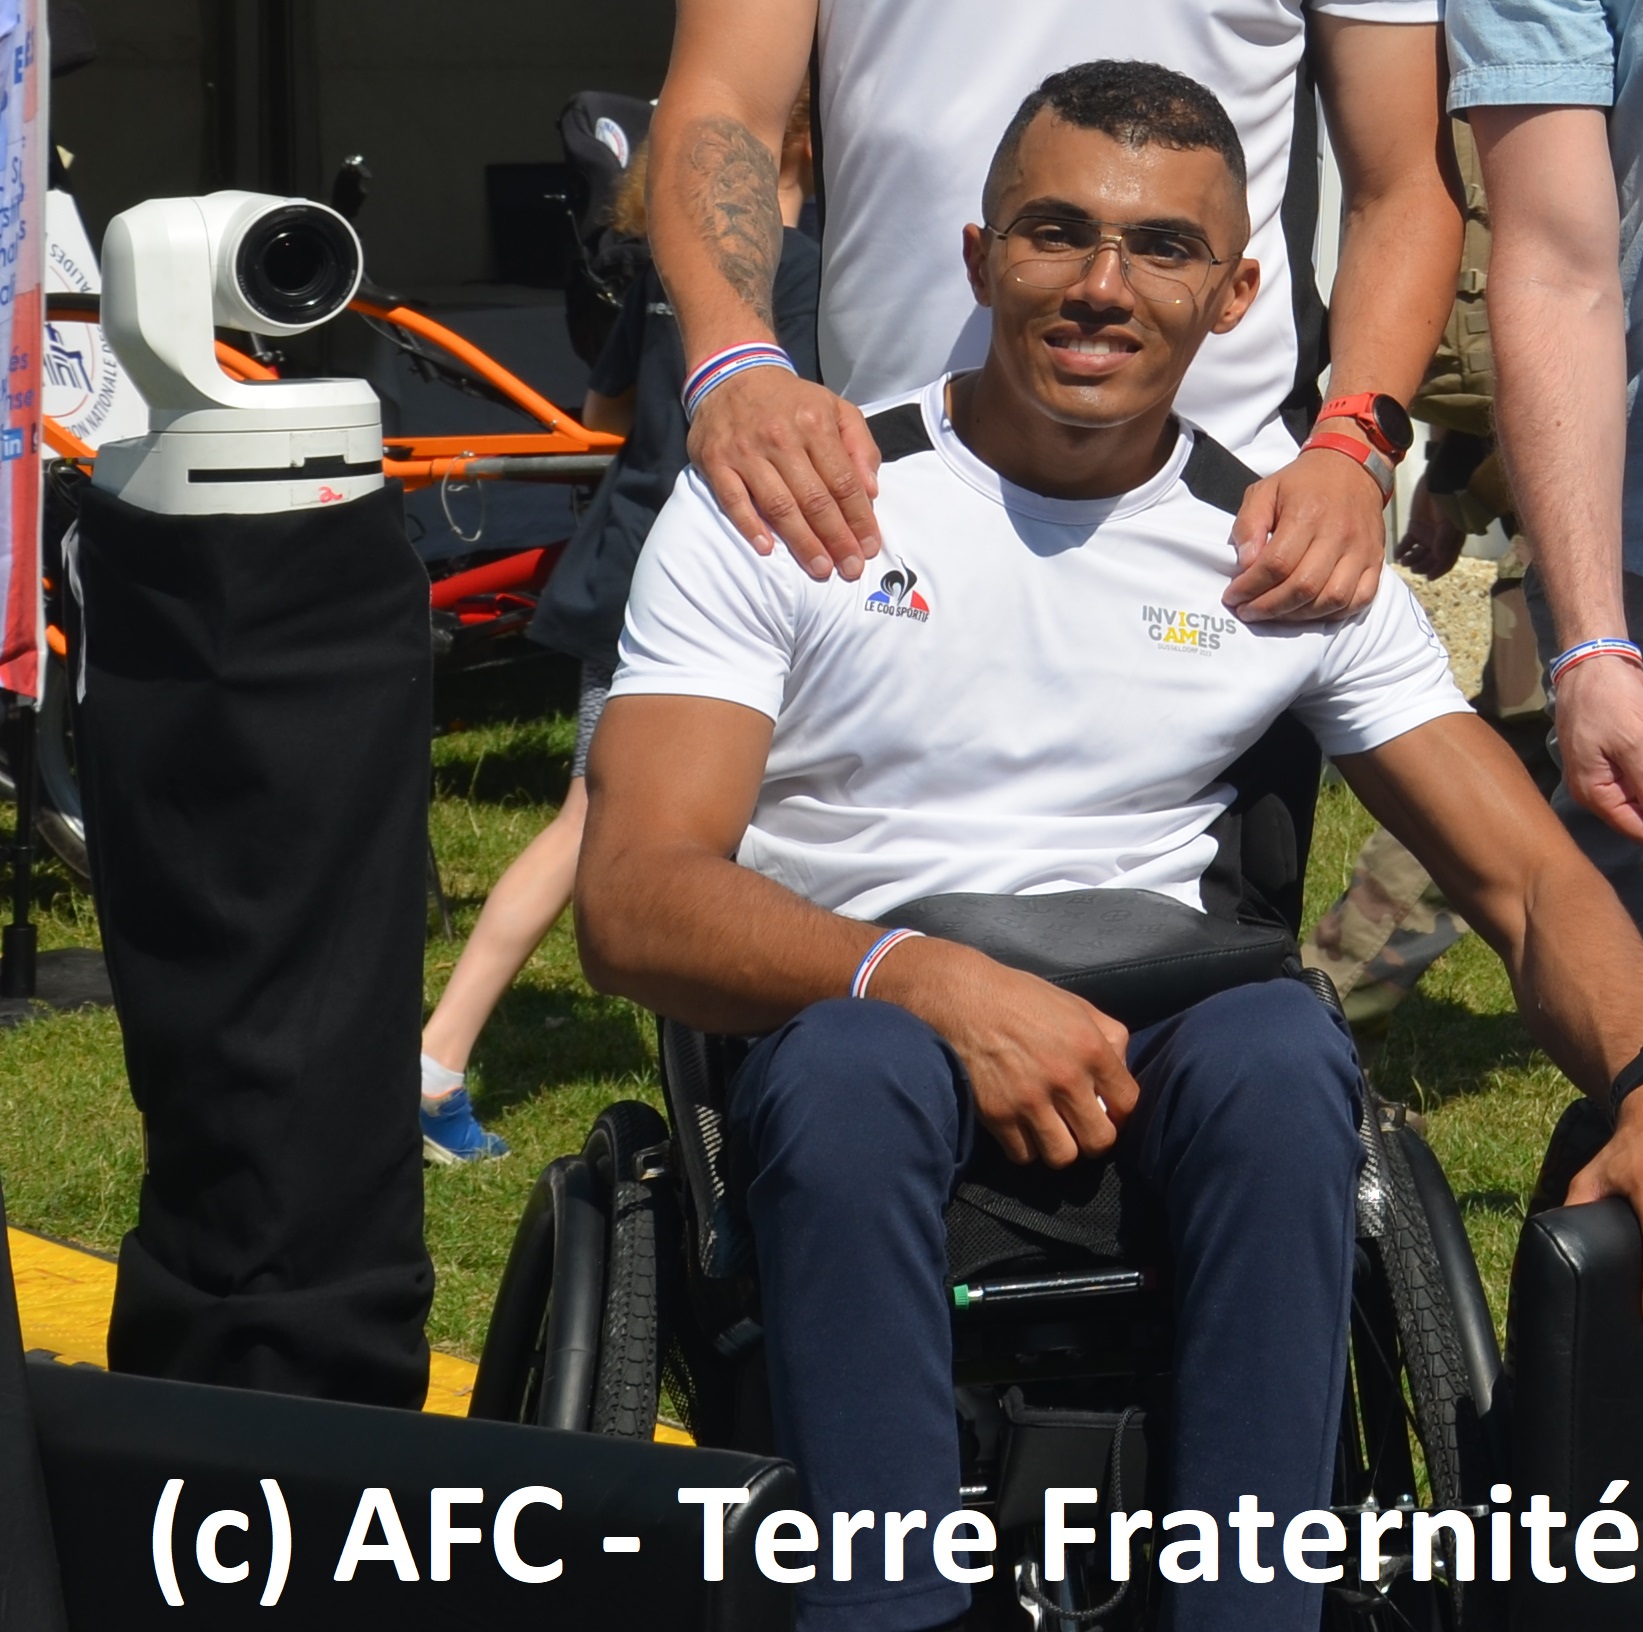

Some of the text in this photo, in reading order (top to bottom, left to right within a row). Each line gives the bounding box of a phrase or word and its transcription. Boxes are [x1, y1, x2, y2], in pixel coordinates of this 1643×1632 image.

[864, 601, 875, 611] LE
[1141, 604, 1237, 635] INVICTUS
[1148, 624, 1220, 651] GAMES
